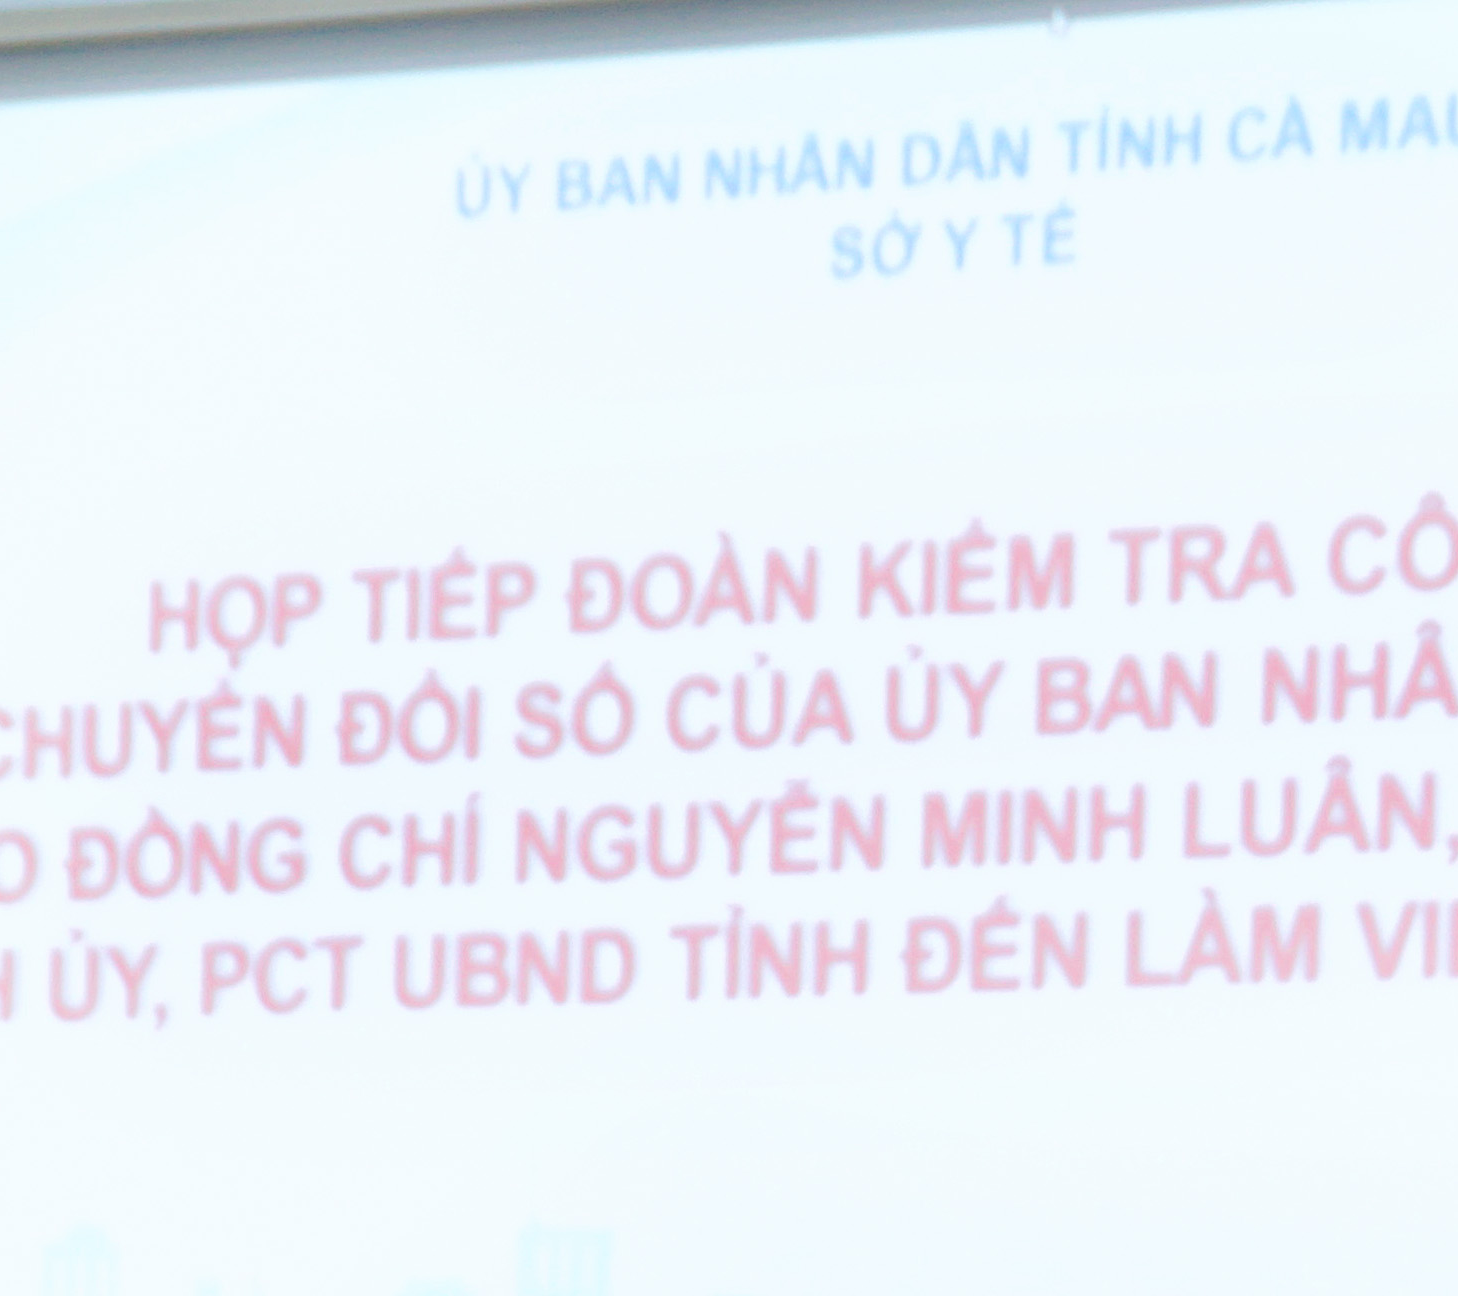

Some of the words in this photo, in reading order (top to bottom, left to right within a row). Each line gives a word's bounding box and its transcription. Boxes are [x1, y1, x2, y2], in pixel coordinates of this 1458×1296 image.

[556, 155, 681, 212] BAN
[704, 133, 875, 199] NHÂN
[902, 121, 1031, 187] DÂN
[944, 220, 976, 270] Y
[149, 573, 324, 668] HỌP
[565, 532, 819, 633] ĐOÀN
[1109, 522, 1295, 604] TRA
[666, 656, 854, 752] CỦA
[885, 648, 1003, 743] ỦY
[1036, 652, 1218, 735] BAN
[339, 796, 480, 890] CHÍ
[922, 785, 1146, 867] MINH
[49, 931, 168, 1028] ỦY,
[201, 936, 363, 1016] PCT
[394, 929, 637, 1010] UBND
[1125, 889, 1321, 988] LÀM
